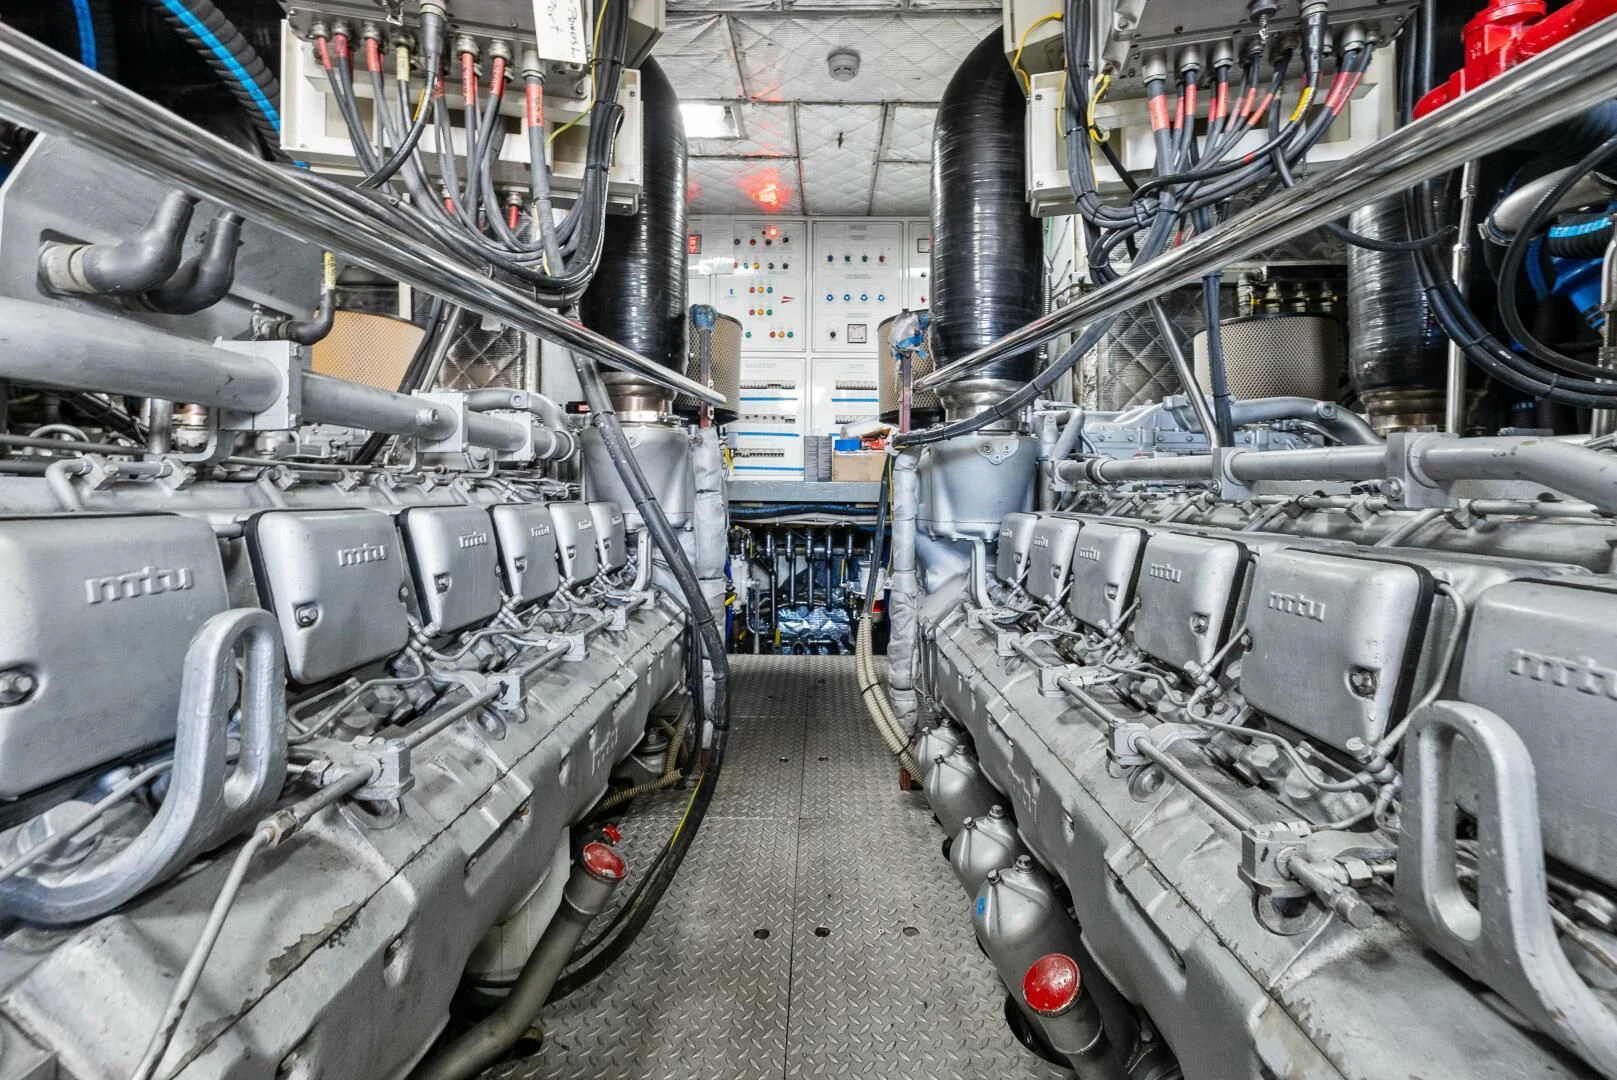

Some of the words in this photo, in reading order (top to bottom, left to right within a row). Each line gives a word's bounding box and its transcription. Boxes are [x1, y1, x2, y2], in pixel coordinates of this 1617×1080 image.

[458, 531, 489, 549] mtu
[531, 524, 550, 537] mtu
[1034, 536, 1049, 548] mtu
[338, 543, 387, 567] mtu
[1080, 547, 1101, 562] mtu
[1149, 563, 1183, 584] mtu
[85, 566, 194, 605] mtu
[1268, 591, 1327, 623] mtu
